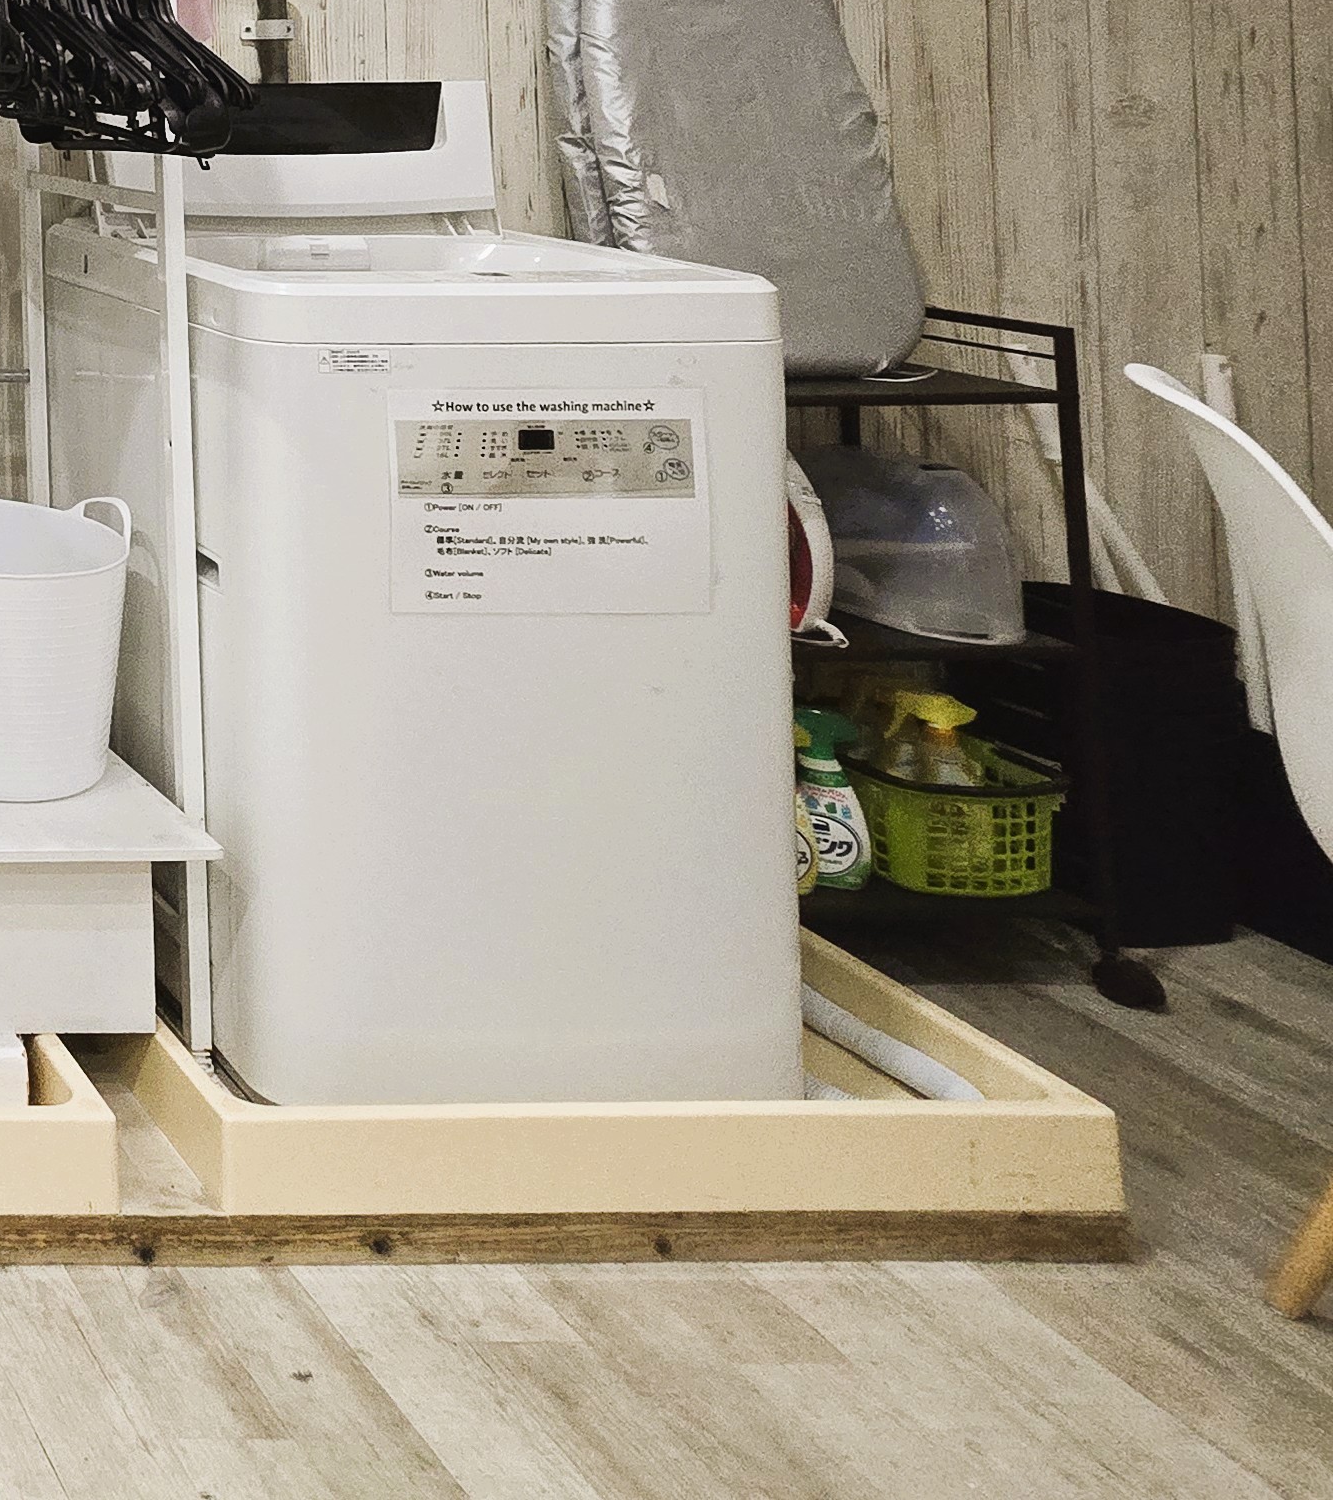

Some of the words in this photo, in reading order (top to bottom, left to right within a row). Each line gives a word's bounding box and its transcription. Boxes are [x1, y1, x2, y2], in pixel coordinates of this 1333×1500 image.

[445, 401, 473, 412] How
[476, 403, 489, 413] to
[493, 404, 513, 412] use
[516, 402, 536, 412] the
[540, 402, 588, 415] washing
[592, 401, 642, 412] machine
